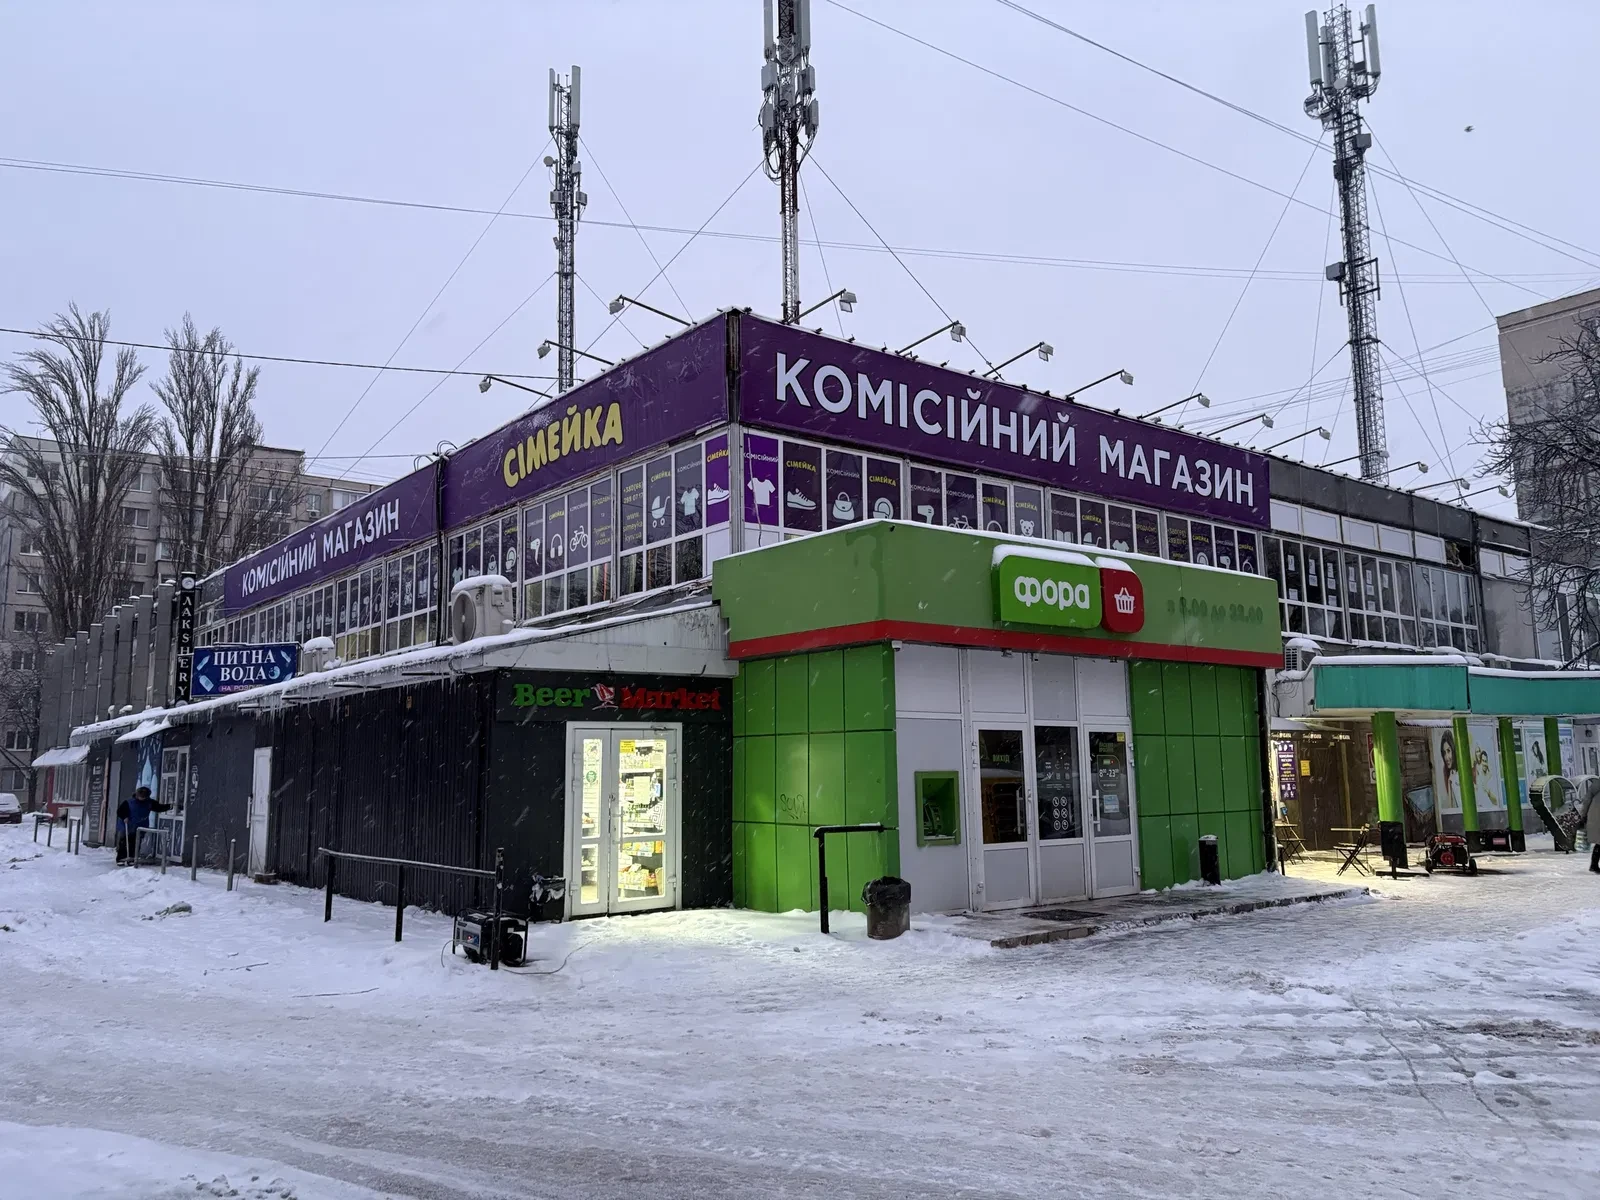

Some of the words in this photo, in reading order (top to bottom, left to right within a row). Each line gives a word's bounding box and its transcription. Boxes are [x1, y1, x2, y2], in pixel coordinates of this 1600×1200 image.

[775, 352, 1076, 467] КОМІСІЙНИЙ
[1099, 434, 1255, 507] МАГАЗИН
[502, 402, 624, 488] СІМЕЙКА
[786, 459, 817, 473] СІМЕЙКА
[826, 468, 860, 479] КОМІСІЙНИЙ
[868, 475, 897, 487] СІМЕЙКА
[1015, 501, 1038, 512] СІМЕЙКА
[241, 532, 317, 598] КОМІСІЙНИЙ
[322, 499, 400, 562] МАГАЗИН
[213, 649, 277, 666] ПИТНА
[220, 665, 268, 684] ВОДА
[513, 683, 591, 708] Beer
[618, 687, 722, 711] Market
[992, 754, 1011, 763] ВИХІД
